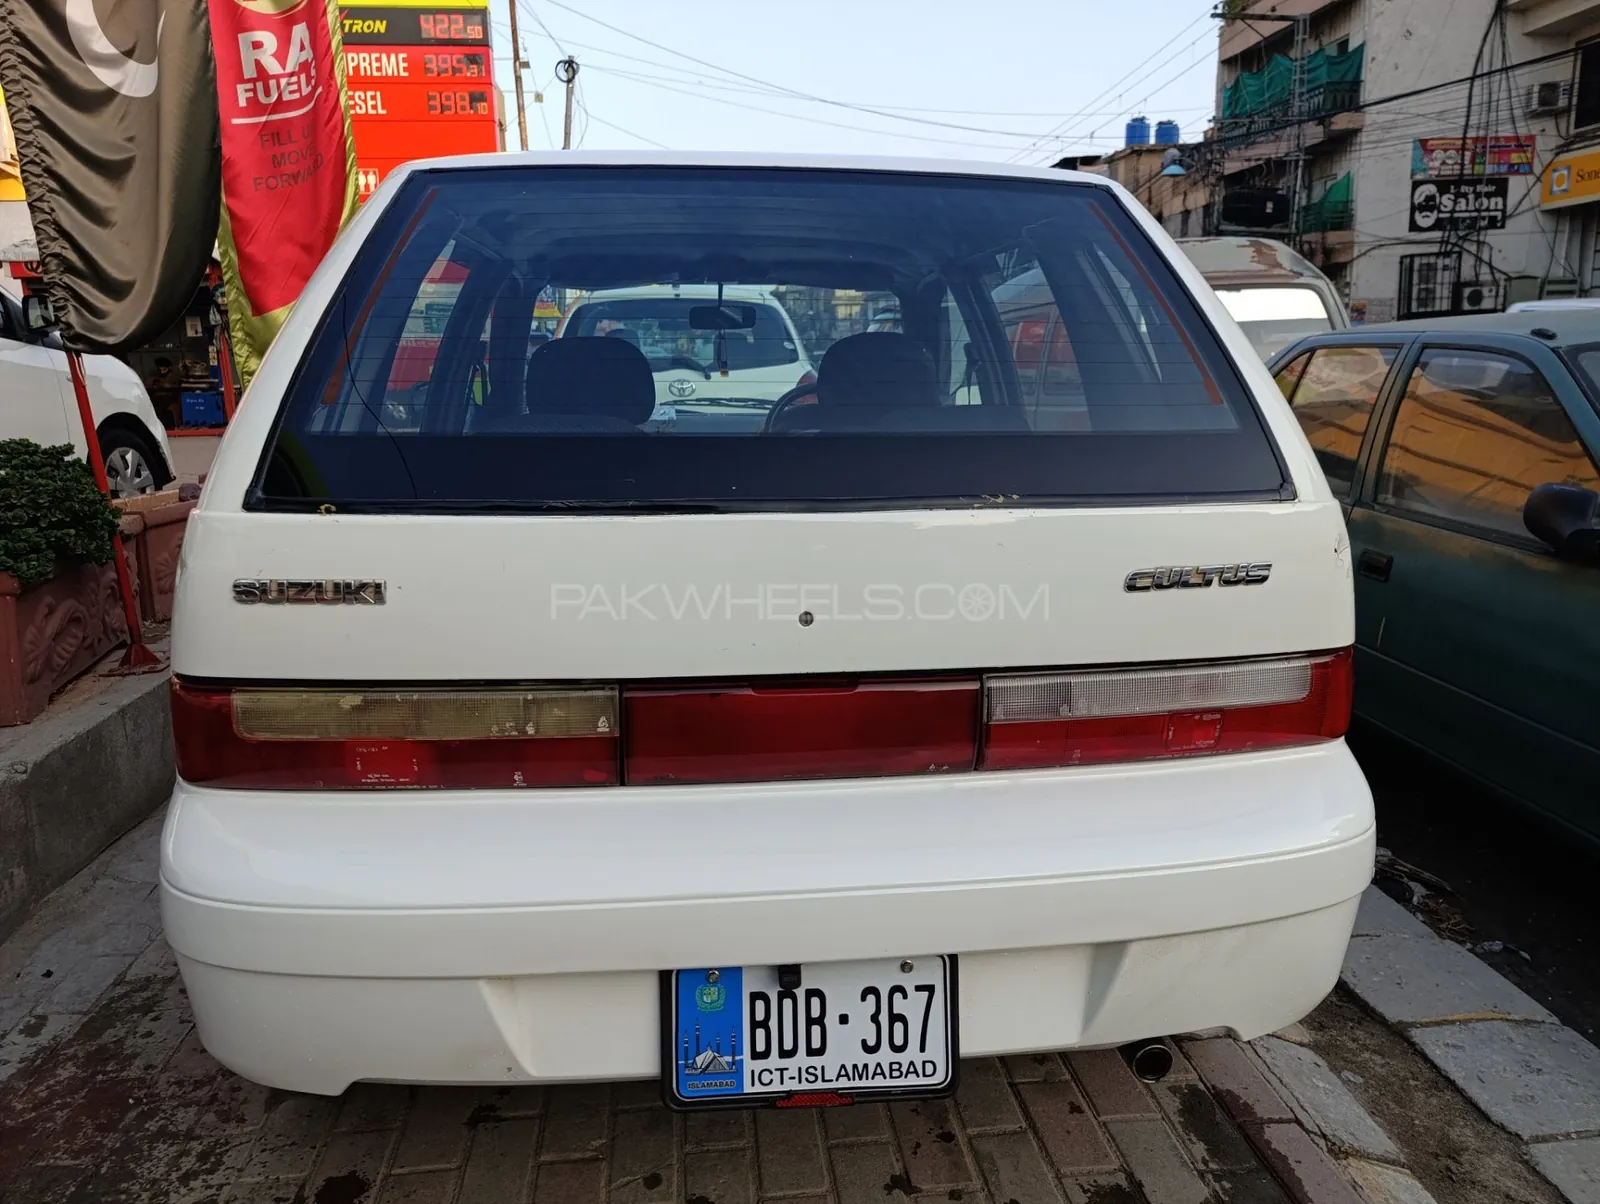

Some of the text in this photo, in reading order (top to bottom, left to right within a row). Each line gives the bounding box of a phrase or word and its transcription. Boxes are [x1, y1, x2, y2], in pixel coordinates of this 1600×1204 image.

[238, 21, 314, 80] RA
[236, 60, 317, 107] FUELS
[260, 129, 297, 149] FILL
[271, 142, 315, 169] MOVE
[252, 152, 324, 192] FORWARD
[1440, 193, 1504, 212] Salon
[1124, 561, 1273, 593] CULTUS
[232, 578, 387, 606] SUZUKI
[687, 1079, 736, 1091] ISLAMABAD
[750, 1059, 938, 1088] ICT-ISLAMABAD
